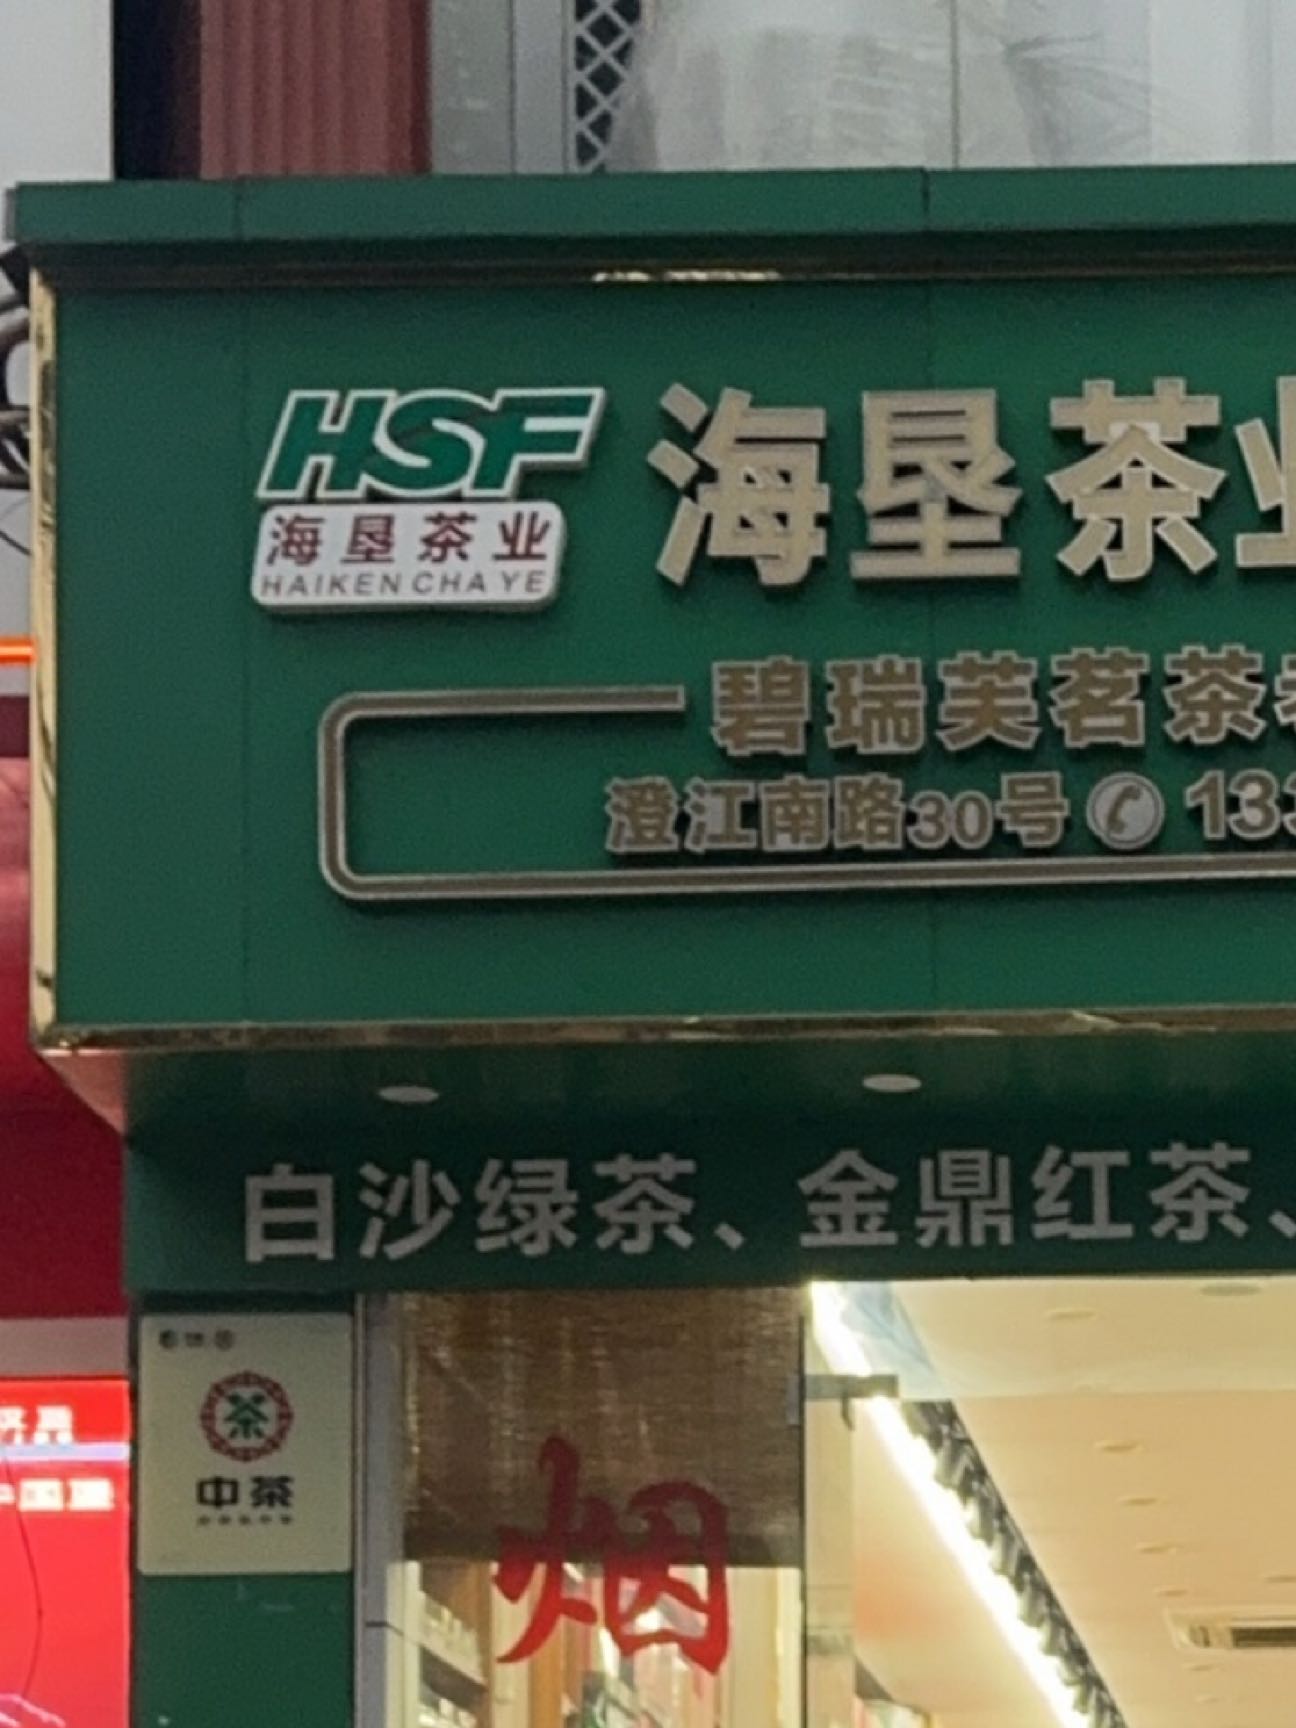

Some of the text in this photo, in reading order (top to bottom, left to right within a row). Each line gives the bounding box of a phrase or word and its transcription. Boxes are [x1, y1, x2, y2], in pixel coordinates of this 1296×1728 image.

[256, 387, 605, 501] HSF
[267, 512, 553, 567] 海垦茶业
[261, 570, 547, 598] HAIKEN CHA YE
[606, 771, 1071, 856] 澄江南路30号
[195, 1474, 296, 1509] 中茶
[490, 1435, 730, 1676] 烟
